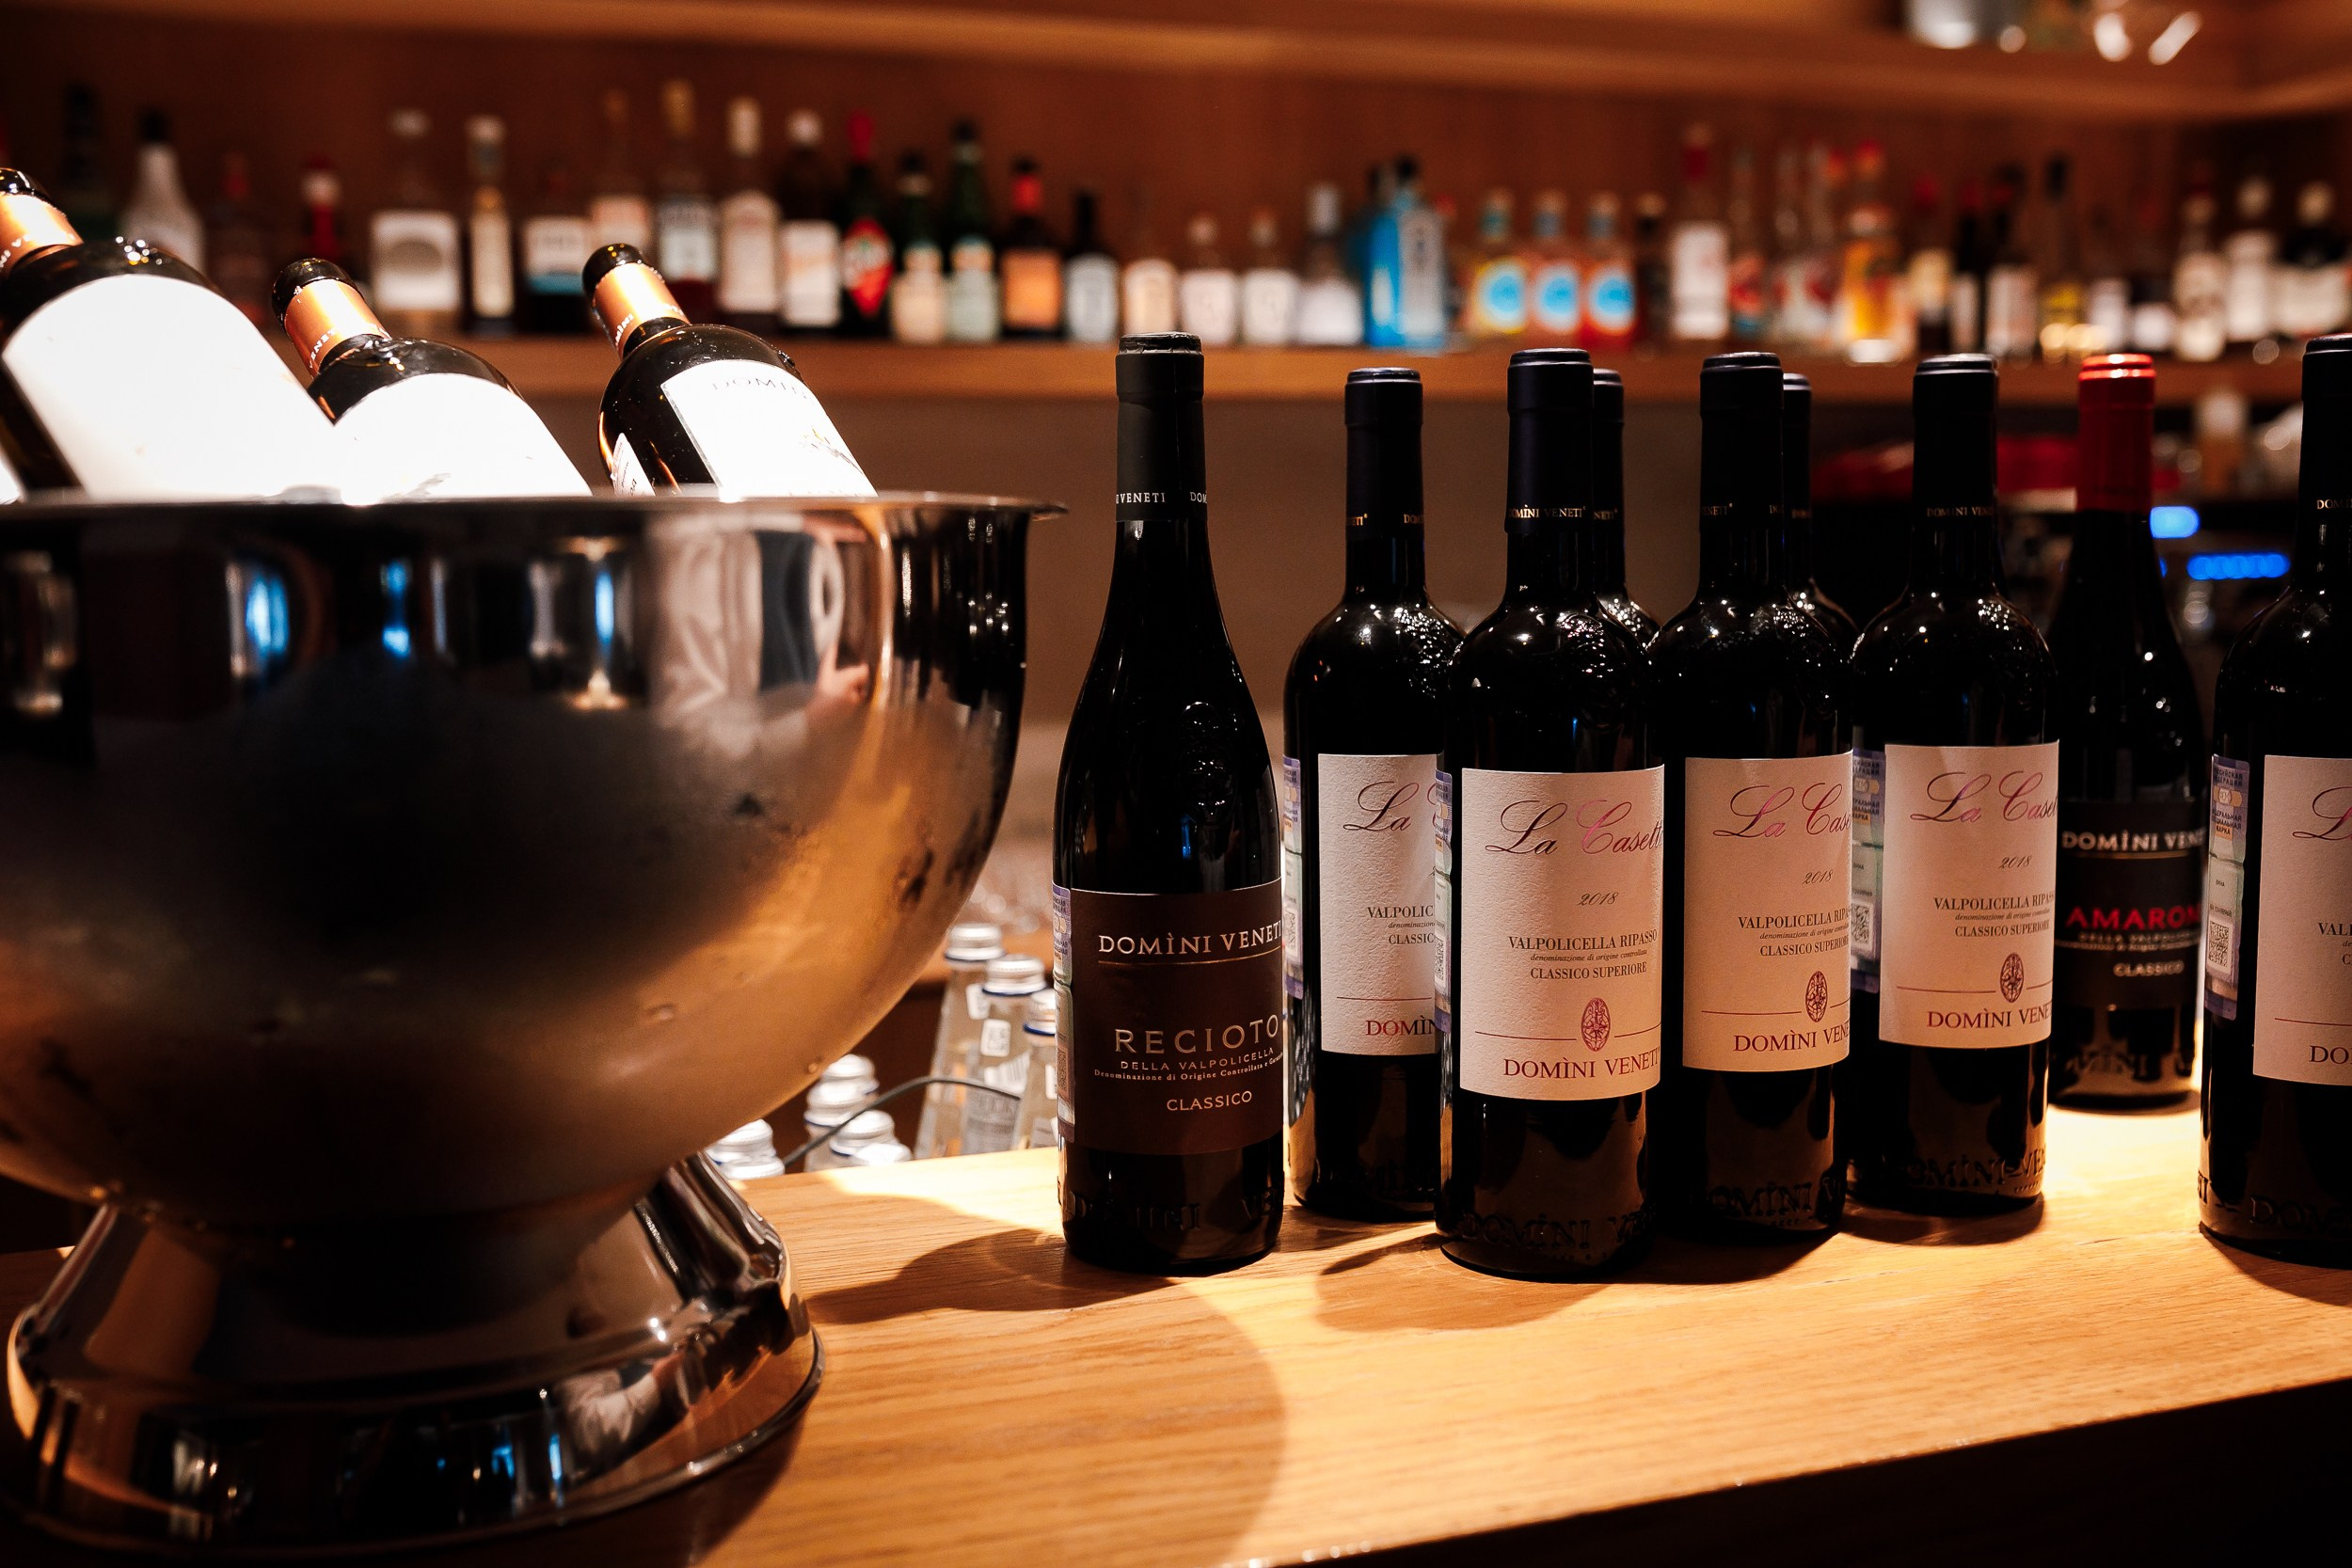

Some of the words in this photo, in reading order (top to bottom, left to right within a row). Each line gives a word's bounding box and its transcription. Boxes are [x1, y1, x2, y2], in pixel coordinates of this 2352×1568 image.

[1120, 492, 1166, 504] VENETI
[1343, 781, 1420, 832] La
[1910, 771, 1992, 823] La
[1712, 785, 1795, 837] La
[1485, 800, 1568, 855] La
[1998, 854, 2032, 870] 2018
[1802, 869, 1834, 885] 2018
[1577, 892, 1619, 907] 2018
[1934, 896, 2029, 911] VALPOLICELLA
[1367, 905, 1434, 919] VALPOLIC
[1738, 911, 1833, 929] VALPOLICELLA
[1954, 913, 2005, 922] denominazione
[1098, 932, 1212, 955] DOMÌNI
[1219, 920, 1281, 951] VENETI
[1759, 931, 1809, 940] denominazione
[1955, 925, 2009, 938] CLASSICO
[2318, 922, 2352, 936] VAL
[1509, 936, 1616, 951] VALPOLICELLA
[1620, 928, 1658, 947] RIPASSO
[1530, 953, 1585, 962] denominazione
[1587, 953, 1595, 961] di
[1596, 952, 1619, 962] origine
[1759, 942, 1813, 957] CLASSICO
[1530, 967, 1590, 980] CLASSICO
[1593, 960, 1647, 979] SUPERIORE
[1927, 1004, 2011, 1029] DOMÌNI
[1115, 1014, 1279, 1055] RECIOTO
[1733, 1029, 1817, 1053] DOMÌNI
[1120, 1061, 1170, 1071] DELLA
[1179, 1047, 1274, 1070] VALPOLICELLA
[2309, 1045, 2352, 1064] DO
[1094, 1069, 1163, 1082] Denominazione
[1181, 1071, 1217, 1082] Origine
[1220, 1063, 1263, 1077] Controllata
[1503, 1055, 1597, 1079] DOMÌNI
[1167, 1090, 1253, 1111] CLASSICO
